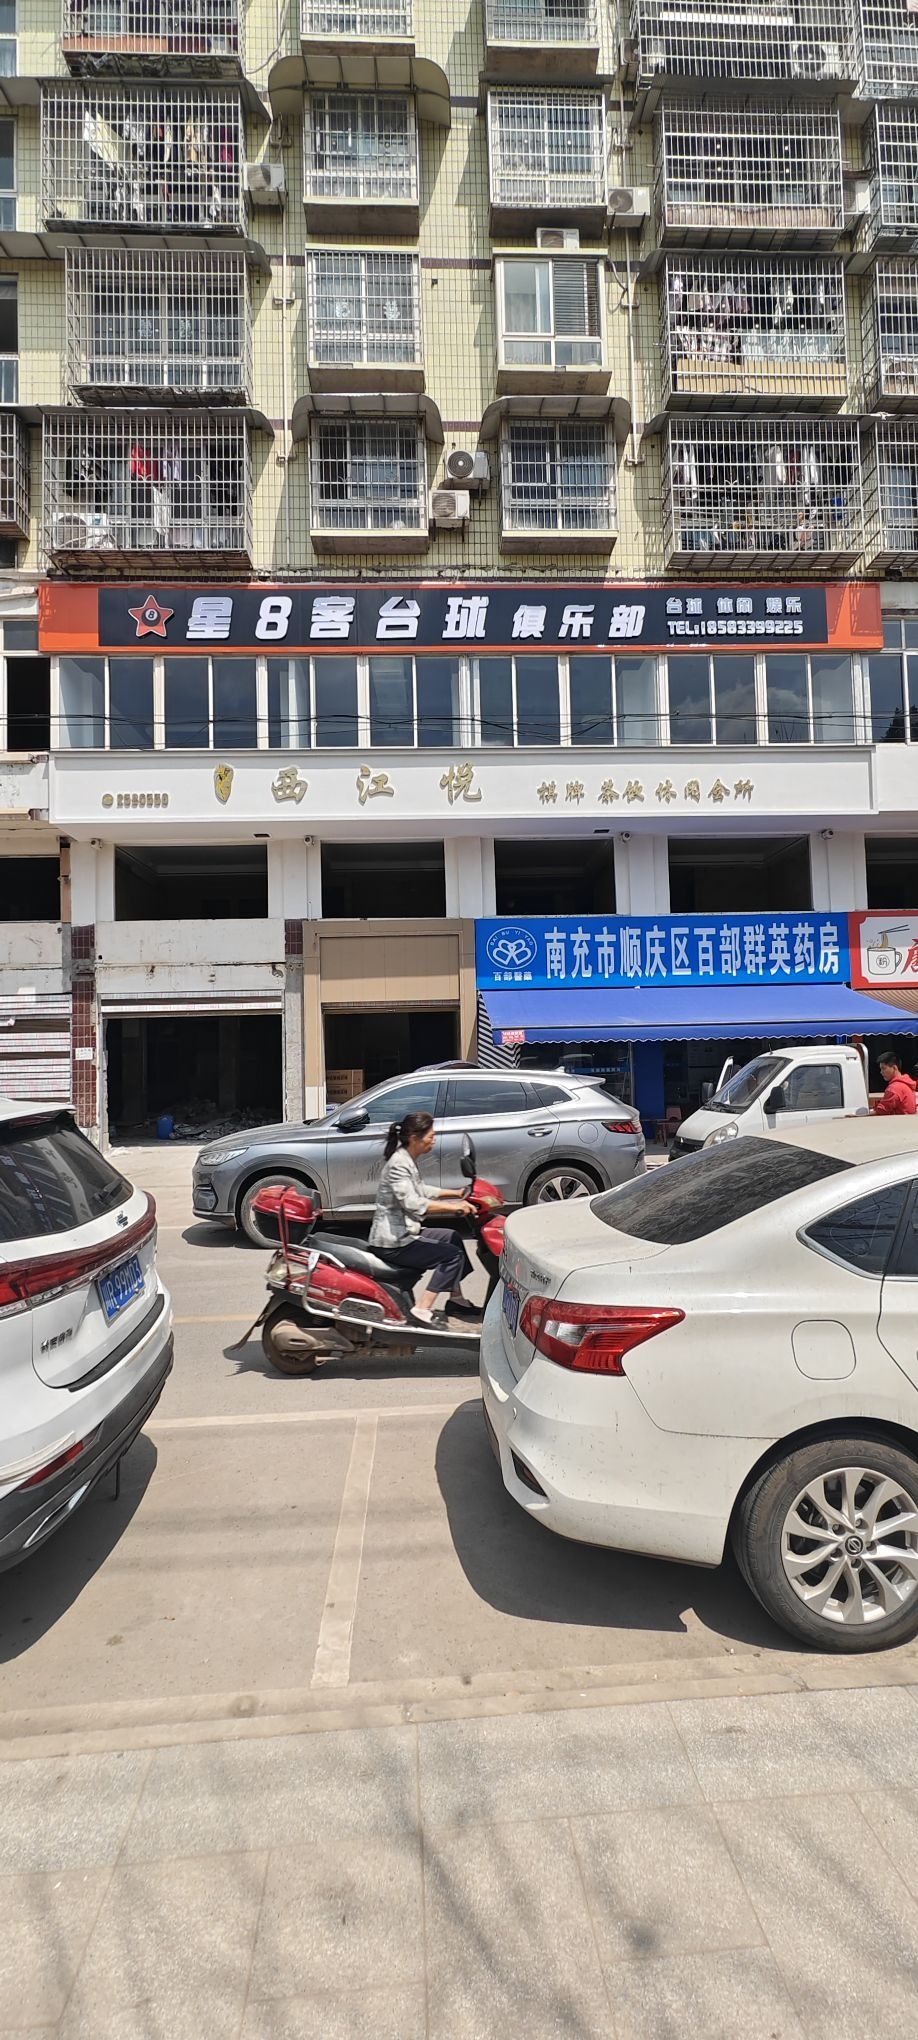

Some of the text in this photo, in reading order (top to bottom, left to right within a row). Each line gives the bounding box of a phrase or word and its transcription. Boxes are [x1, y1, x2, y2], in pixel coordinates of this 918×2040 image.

[544, 921, 839, 979] 南充市顺庆区百部群英药房
